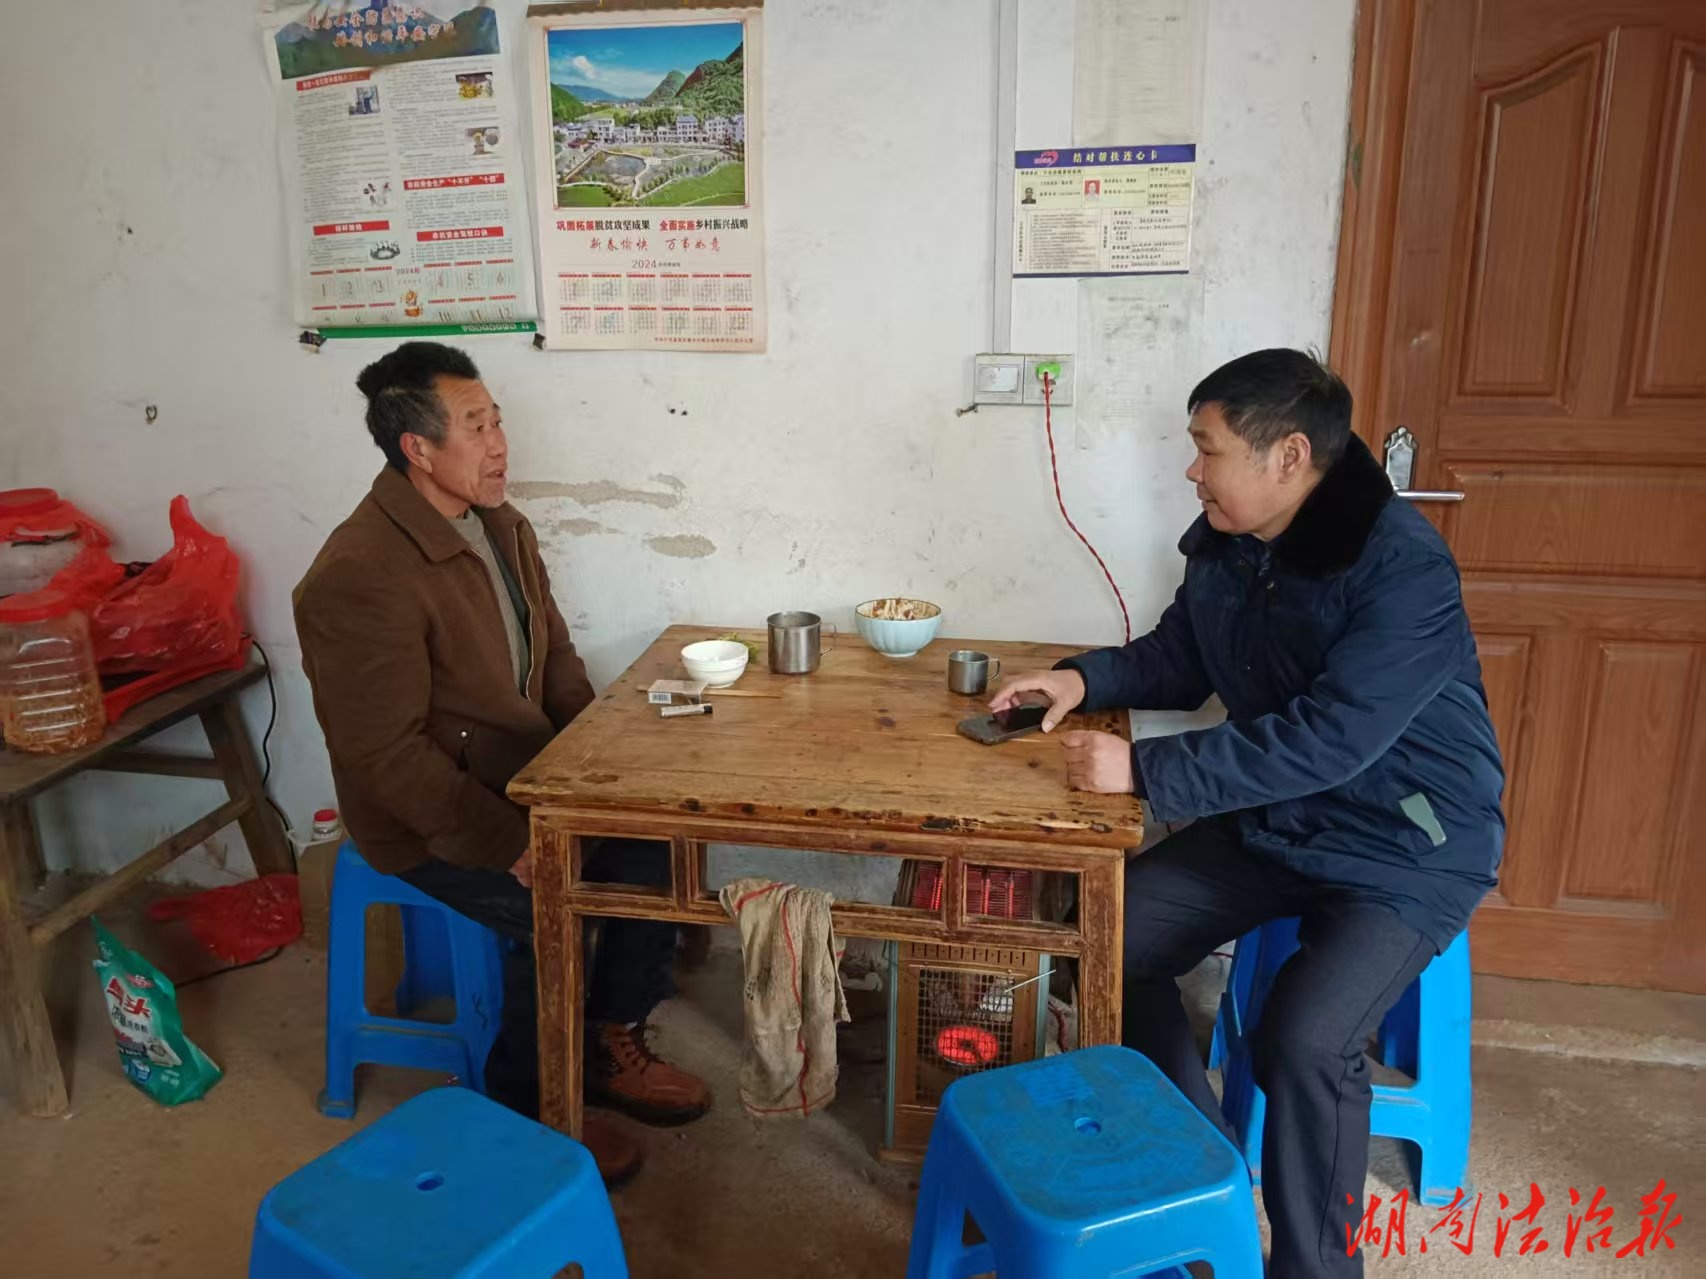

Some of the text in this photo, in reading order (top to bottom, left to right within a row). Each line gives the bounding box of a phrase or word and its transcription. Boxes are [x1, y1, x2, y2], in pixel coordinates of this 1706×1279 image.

[1072, 151, 1158, 163] 结对帮扶连心卡
[556, 218, 749, 232] 巩固拓展脱贫攻坚成果 全面实施乡村振兴战略
[589, 237, 721, 252] 新春愉快 万事如意
[632, 259, 657, 269] 2024
